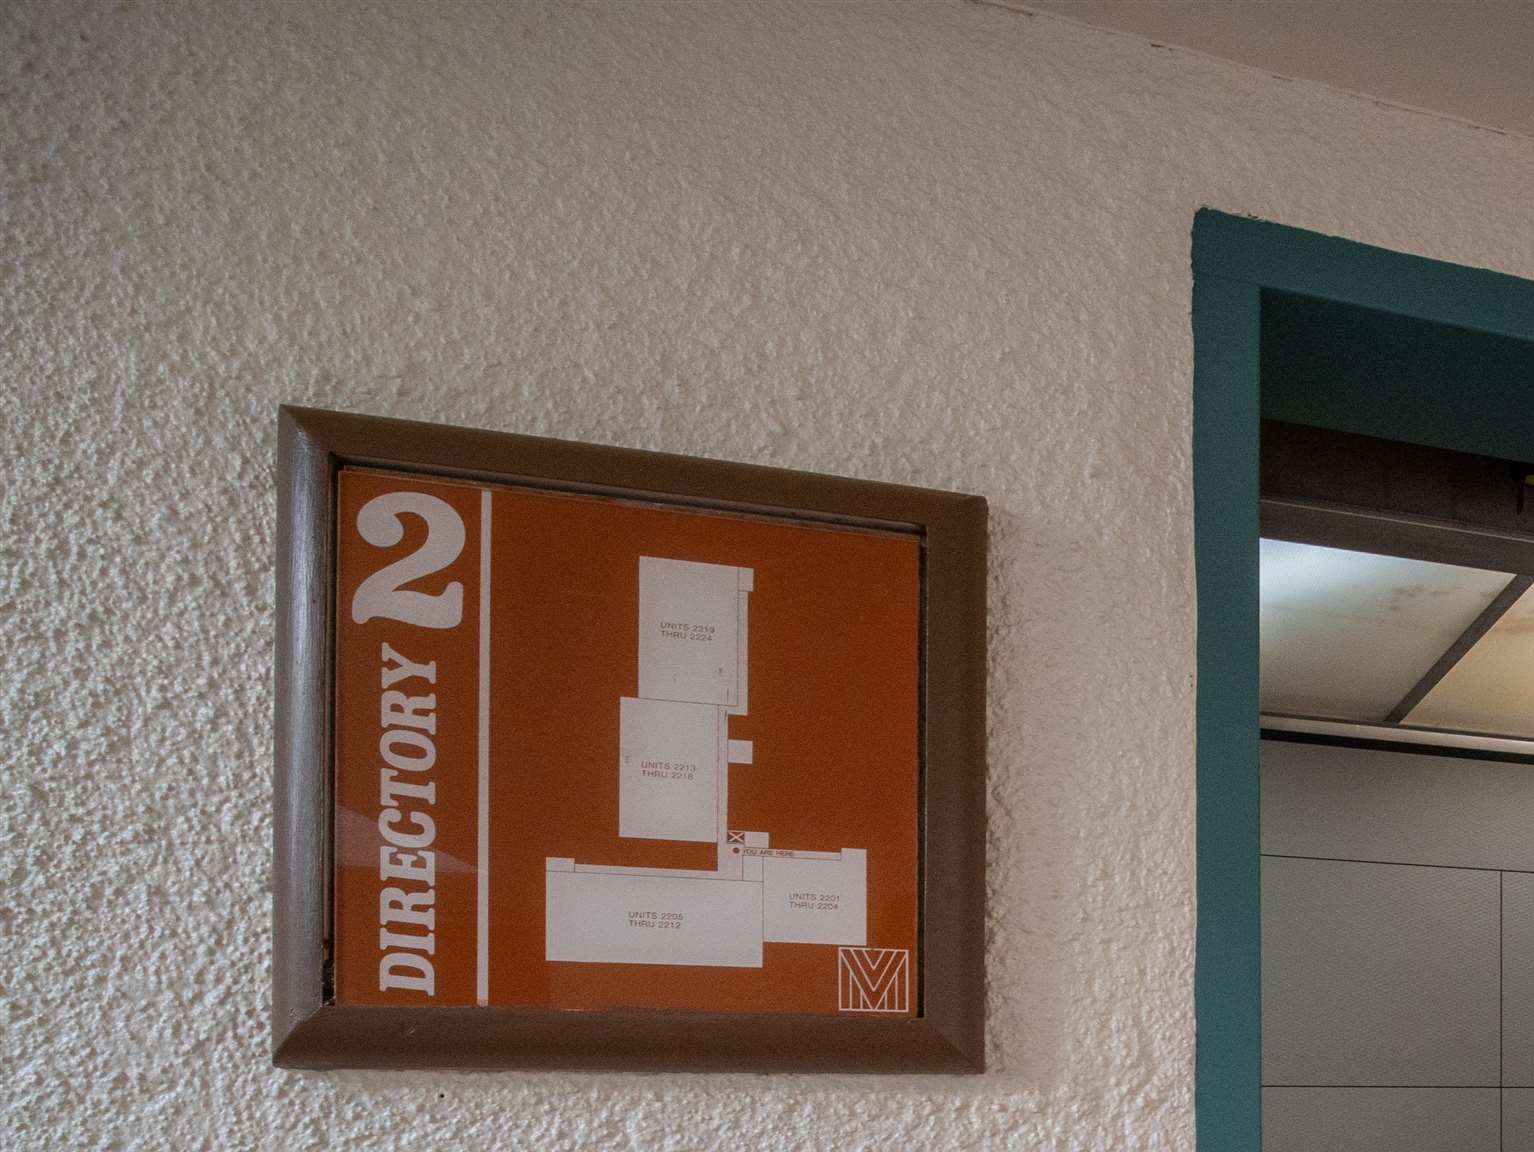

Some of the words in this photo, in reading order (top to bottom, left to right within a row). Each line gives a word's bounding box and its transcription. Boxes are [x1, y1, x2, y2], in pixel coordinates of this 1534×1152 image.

[351, 491, 466, 630] 2
[660, 621, 689, 631] UNITS
[661, 630, 688, 640] THRU
[641, 761, 671, 770] UNITS
[673, 763, 697, 772] 2213
[641, 769, 668, 778] THRU
[378, 643, 437, 997] DIRECTORY
[788, 893, 817, 901] UNITS
[789, 901, 815, 909] THRU
[628, 911, 658, 920] UNITS
[629, 919, 656, 928] THRU
